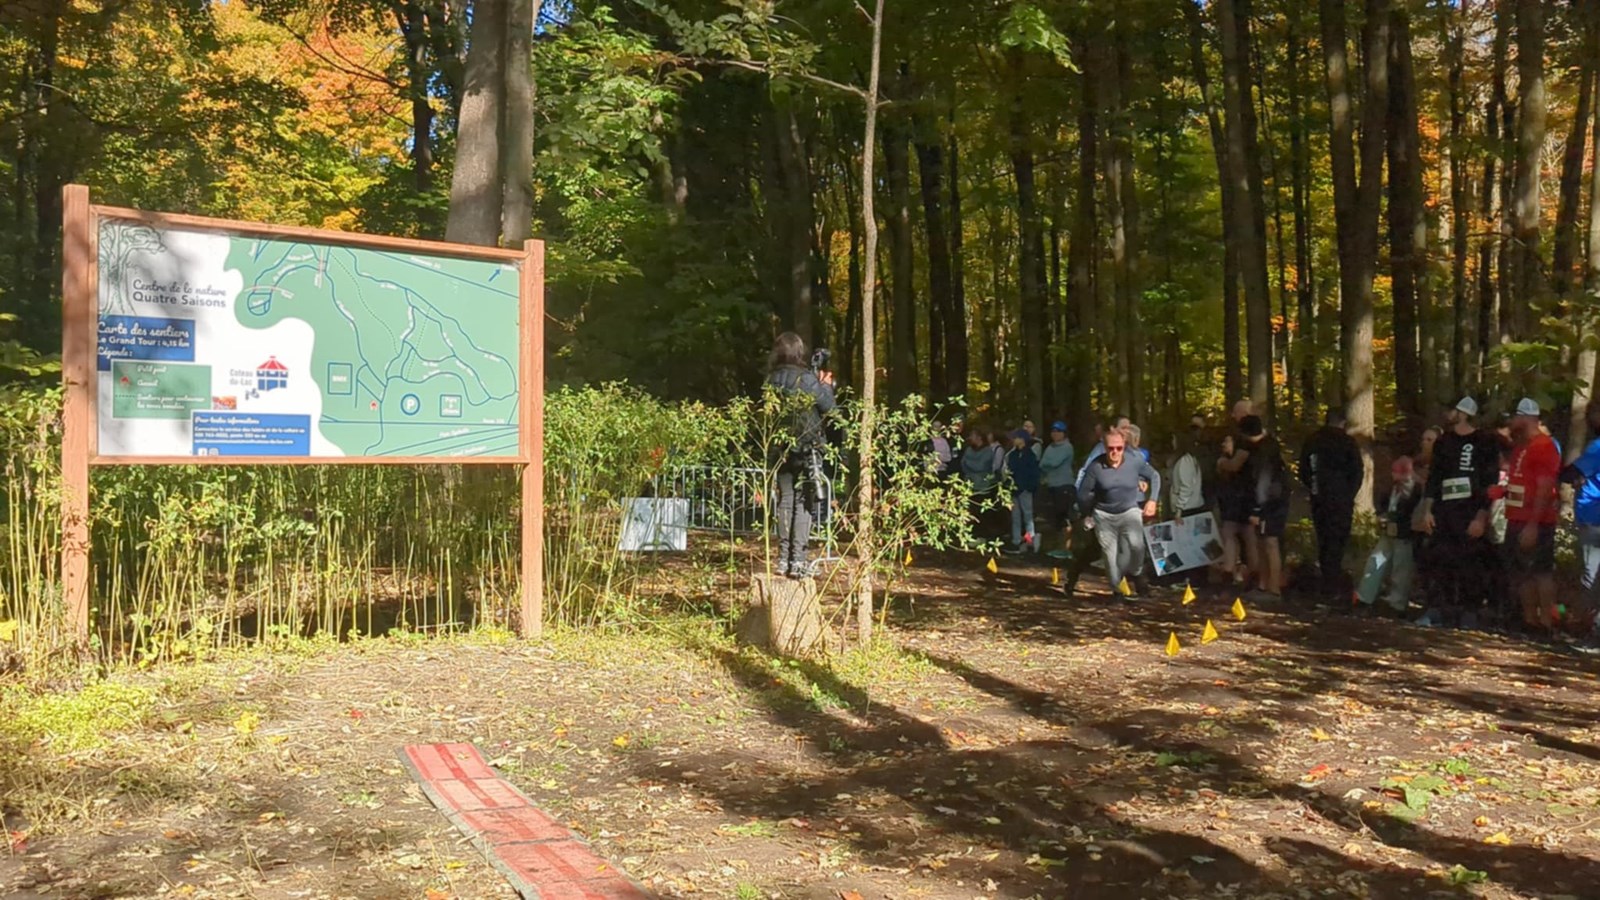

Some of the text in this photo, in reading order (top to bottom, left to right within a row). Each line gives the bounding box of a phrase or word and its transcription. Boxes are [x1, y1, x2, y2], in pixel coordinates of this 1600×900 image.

[133, 279, 226, 296] Centre de la nature
[133, 291, 226, 308] Quatre Saisons
[98, 321, 189, 338] Carte des sentiers
[109, 336, 136, 345] Grand
[179, 338, 190, 347] km
[406, 399, 415, 411] P
